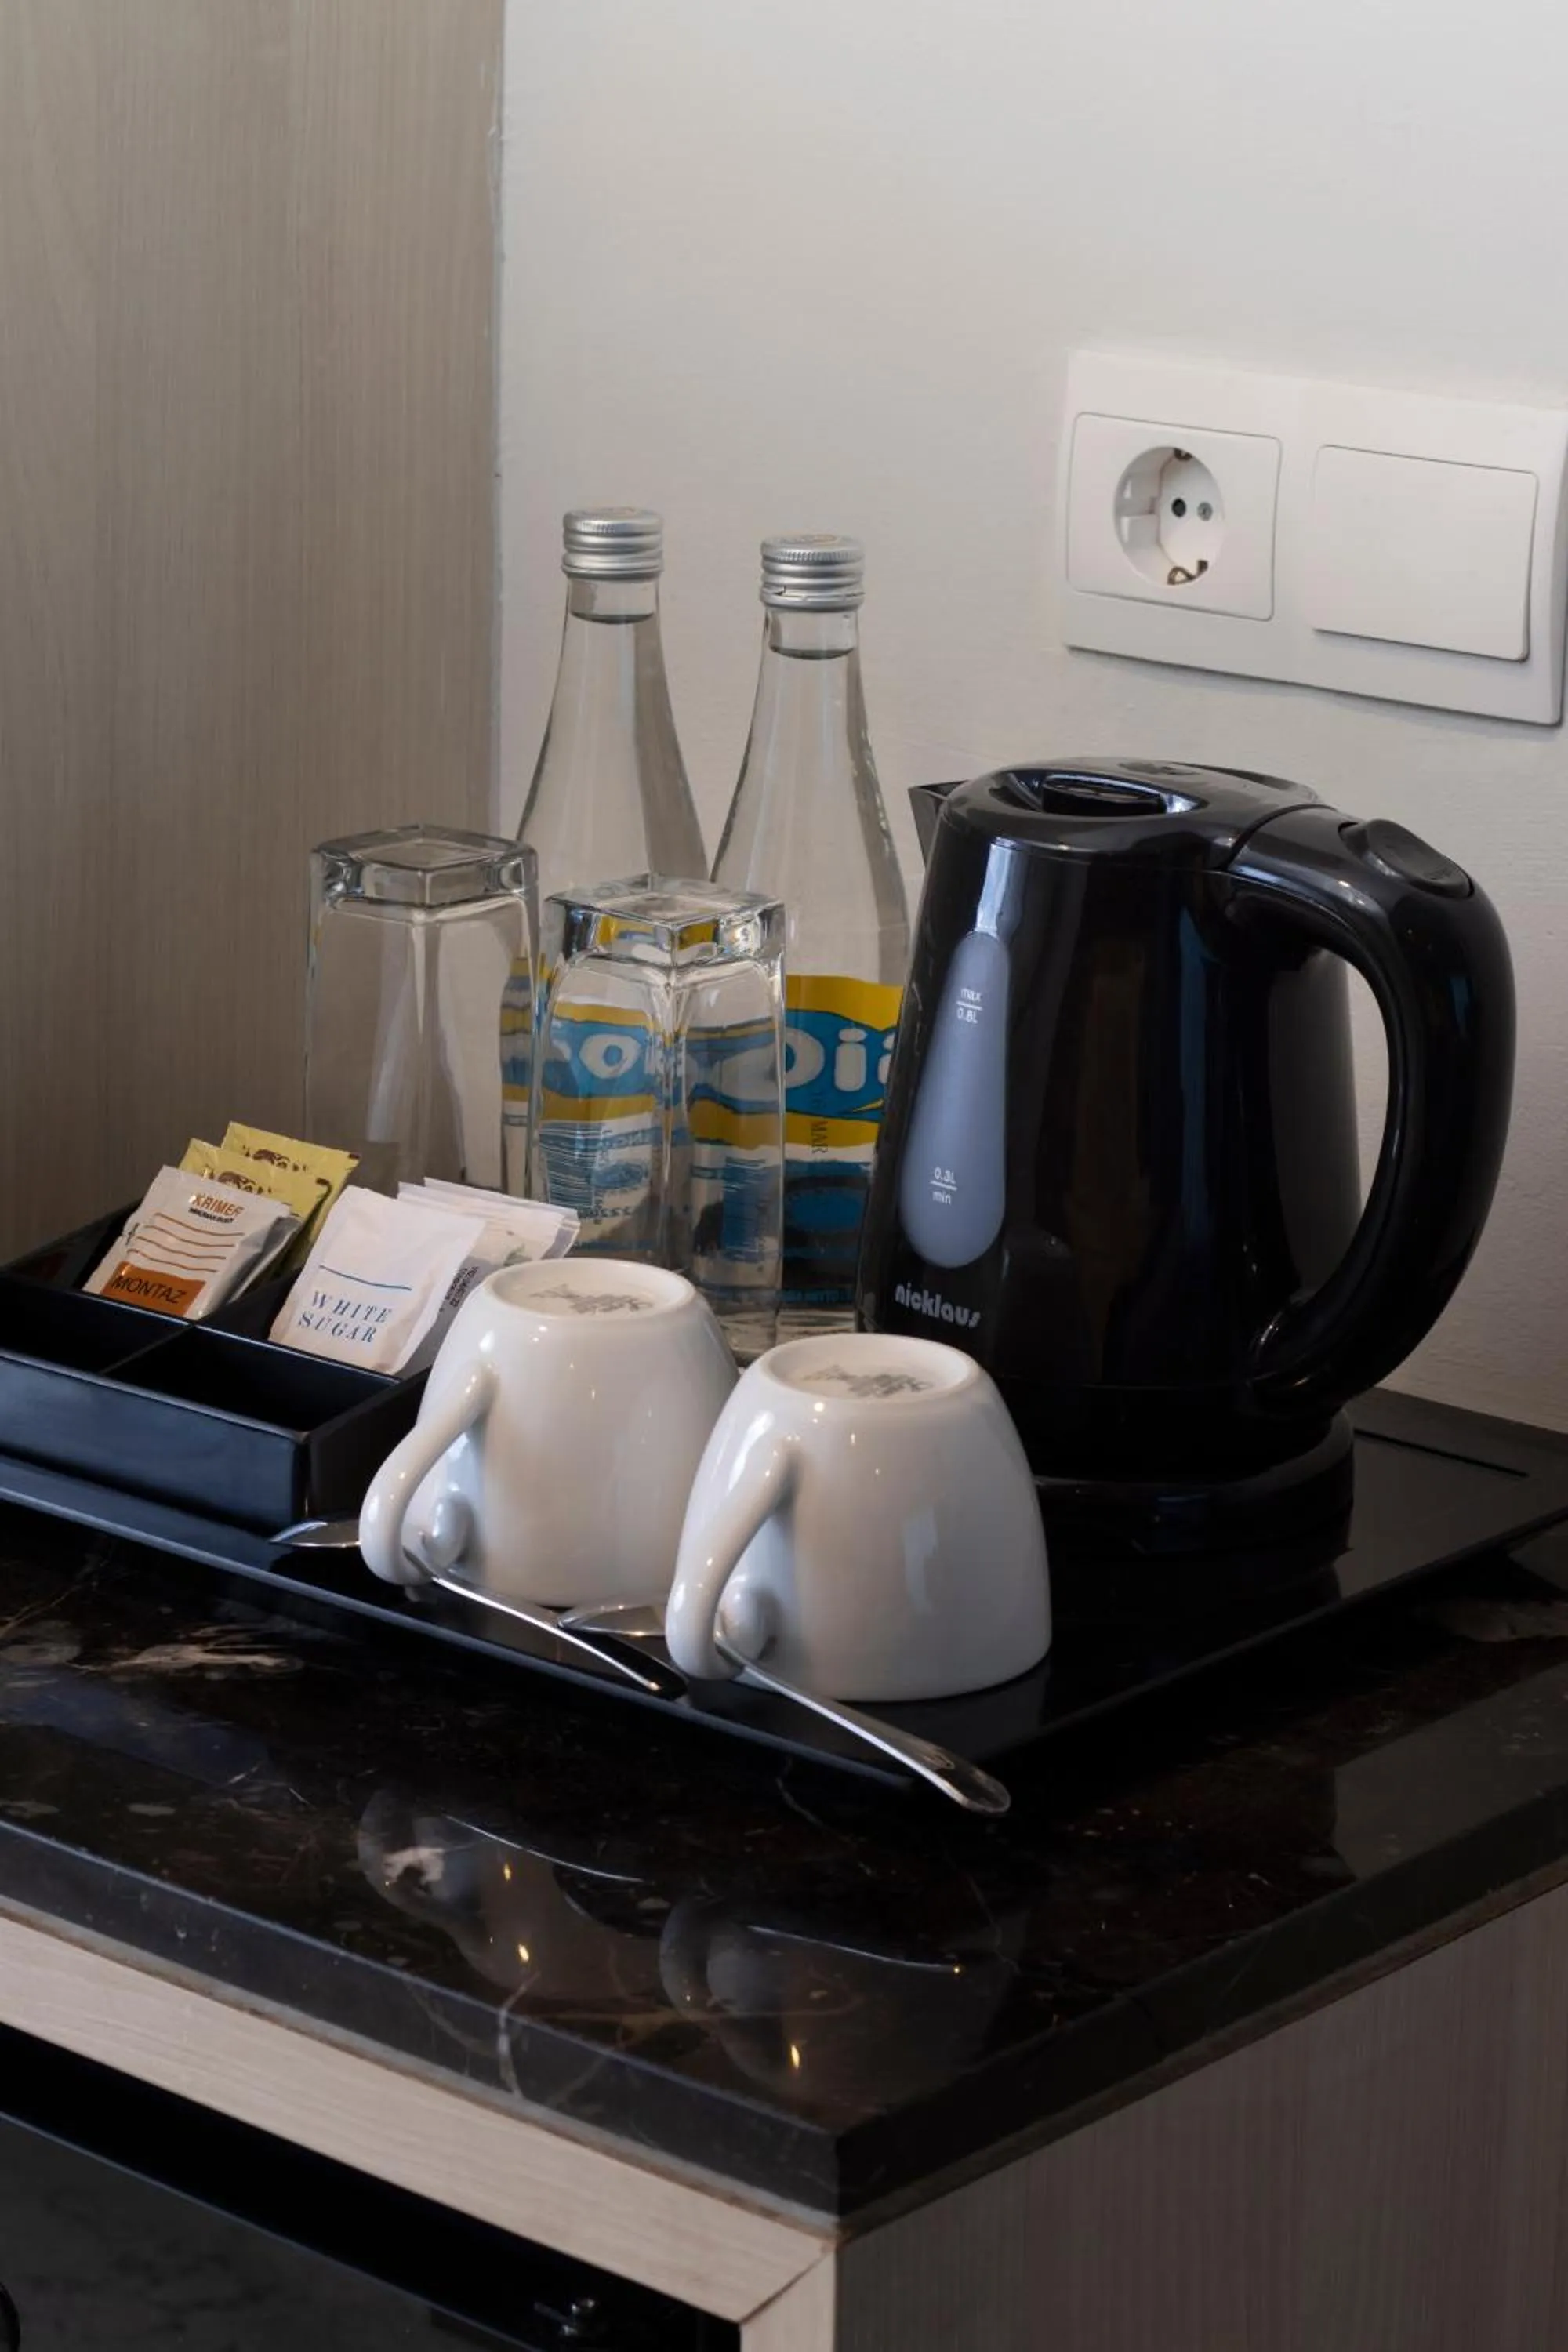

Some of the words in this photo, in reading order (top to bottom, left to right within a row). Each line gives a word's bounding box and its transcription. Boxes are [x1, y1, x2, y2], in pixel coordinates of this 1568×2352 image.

[960, 988, 982, 1002] max
[932, 1190, 951, 1205] min
[111, 1275, 187, 1305] MONTAZ
[895, 1280, 981, 1329] nicklaus
[311, 1290, 392, 1323] WHITE
[298, 1311, 377, 1343] SUGAR
